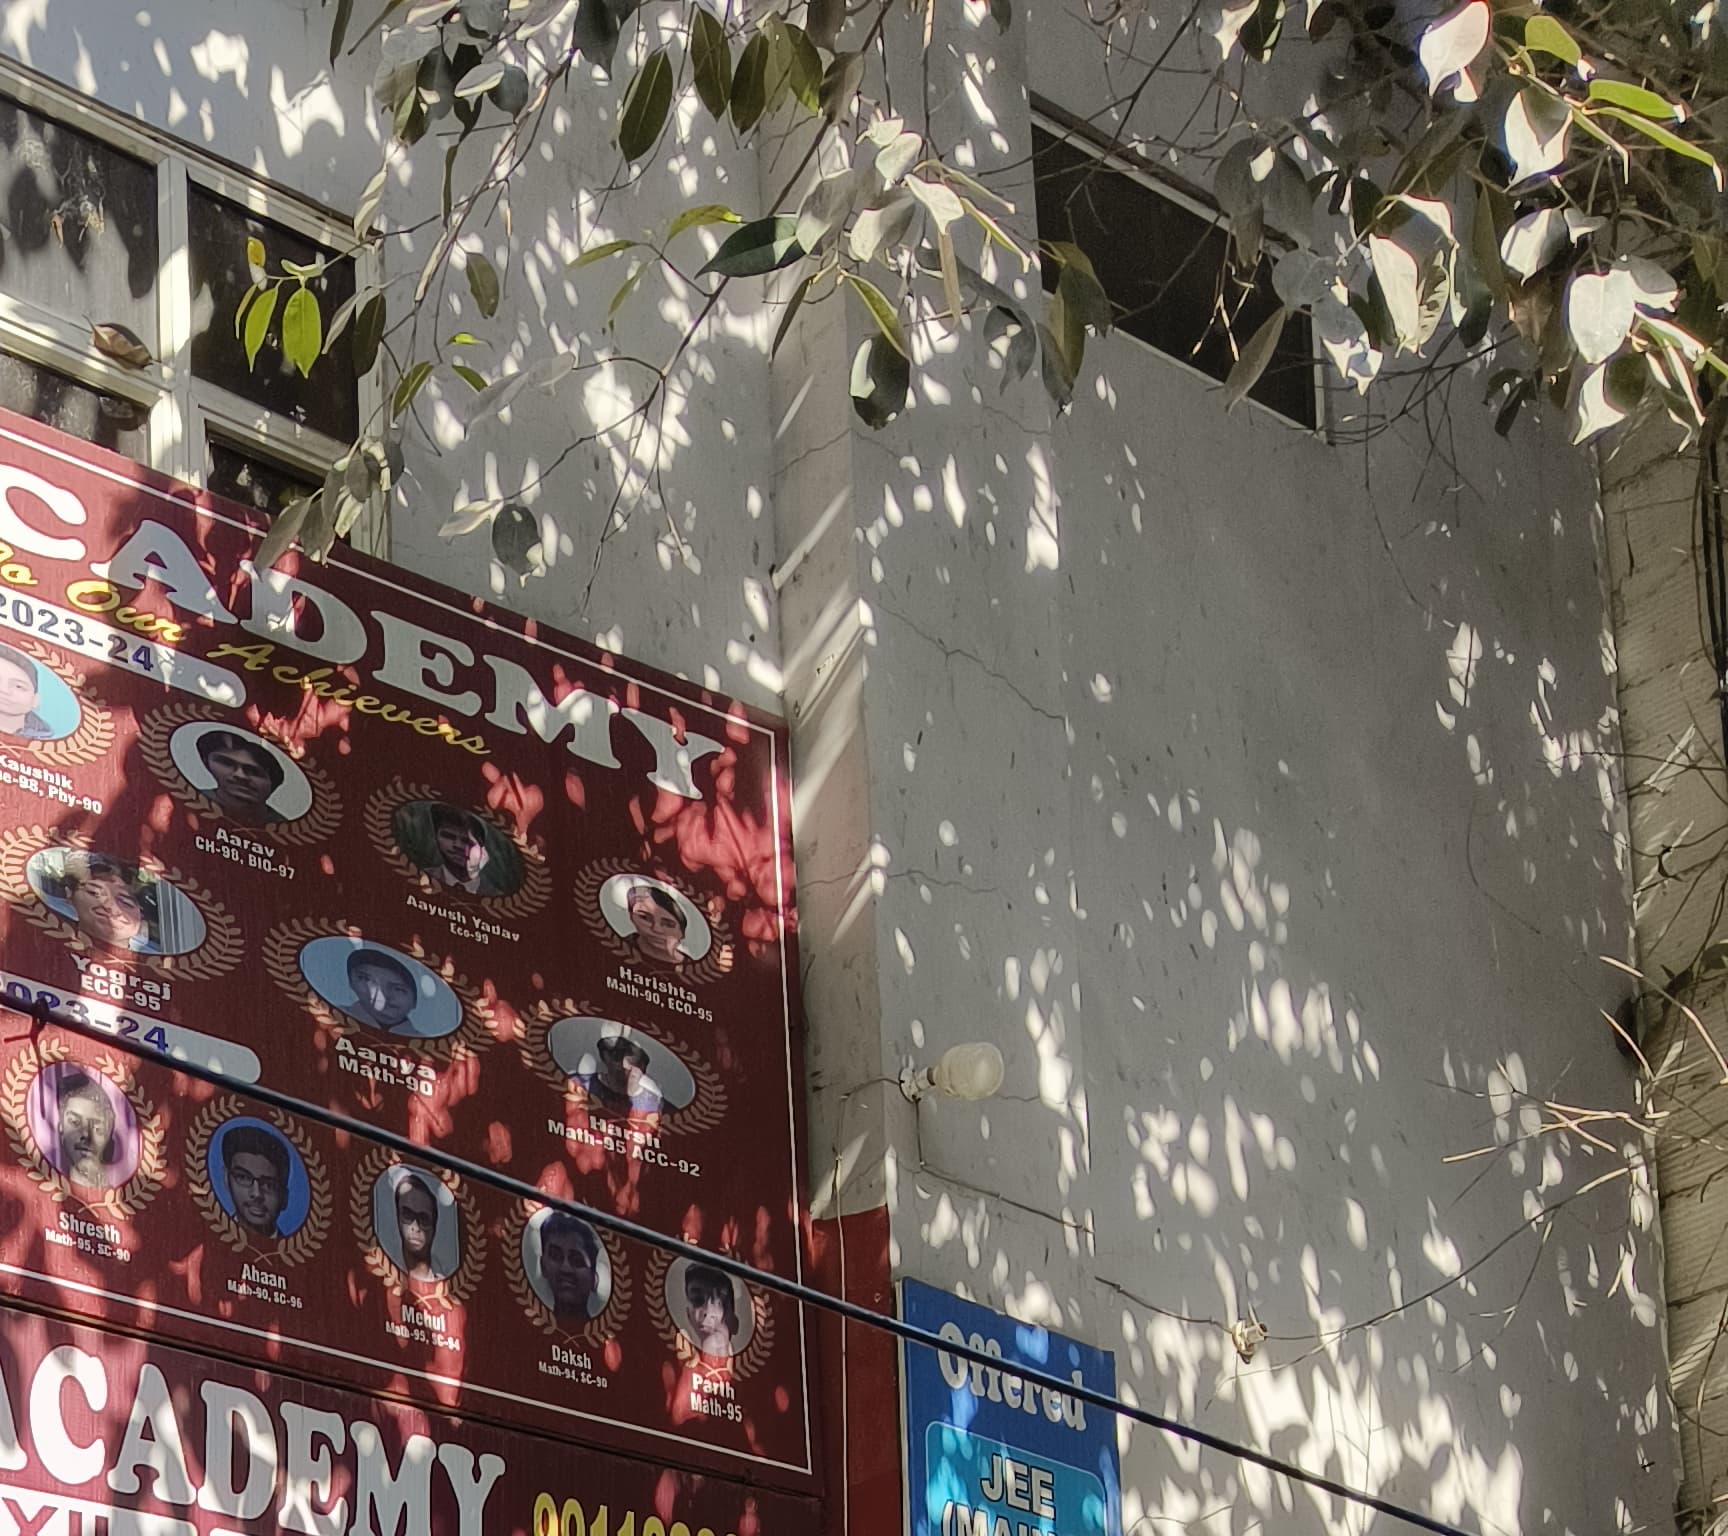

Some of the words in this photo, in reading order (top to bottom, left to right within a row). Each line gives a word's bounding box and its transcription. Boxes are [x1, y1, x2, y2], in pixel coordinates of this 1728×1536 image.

[65, 578, 187, 642] Our
[206, 641, 493, 756] Achievers
[216, 827, 275, 858] Aarav
[248, 853, 295, 880] BIO-97
[406, 895, 466, 924] Aayush
[472, 916, 520, 942] Yadav
[70, 953, 171, 1000] Yograj
[81, 974, 161, 1011] ECO-95
[619, 966, 697, 1003] Harishta
[668, 998, 713, 1022] ECO-95
[335, 1037, 437, 1081] Aanya
[338, 1055, 433, 1096] Math-90
[548, 1119, 626, 1154] Math-95
[632, 1145, 700, 1177] ACC-92
[589, 1115, 661, 1149] Harsh
[59, 1211, 121, 1244] Shresth
[401, 1304, 446, 1332] Mehul
[551, 1344, 592, 1370] Daksh
[692, 1372, 734, 1400] Parth
[937, 1322, 1087, 1431] Offered
[690, 1391, 743, 1422] Math-95
[980, 1454, 1056, 1520] JEE
